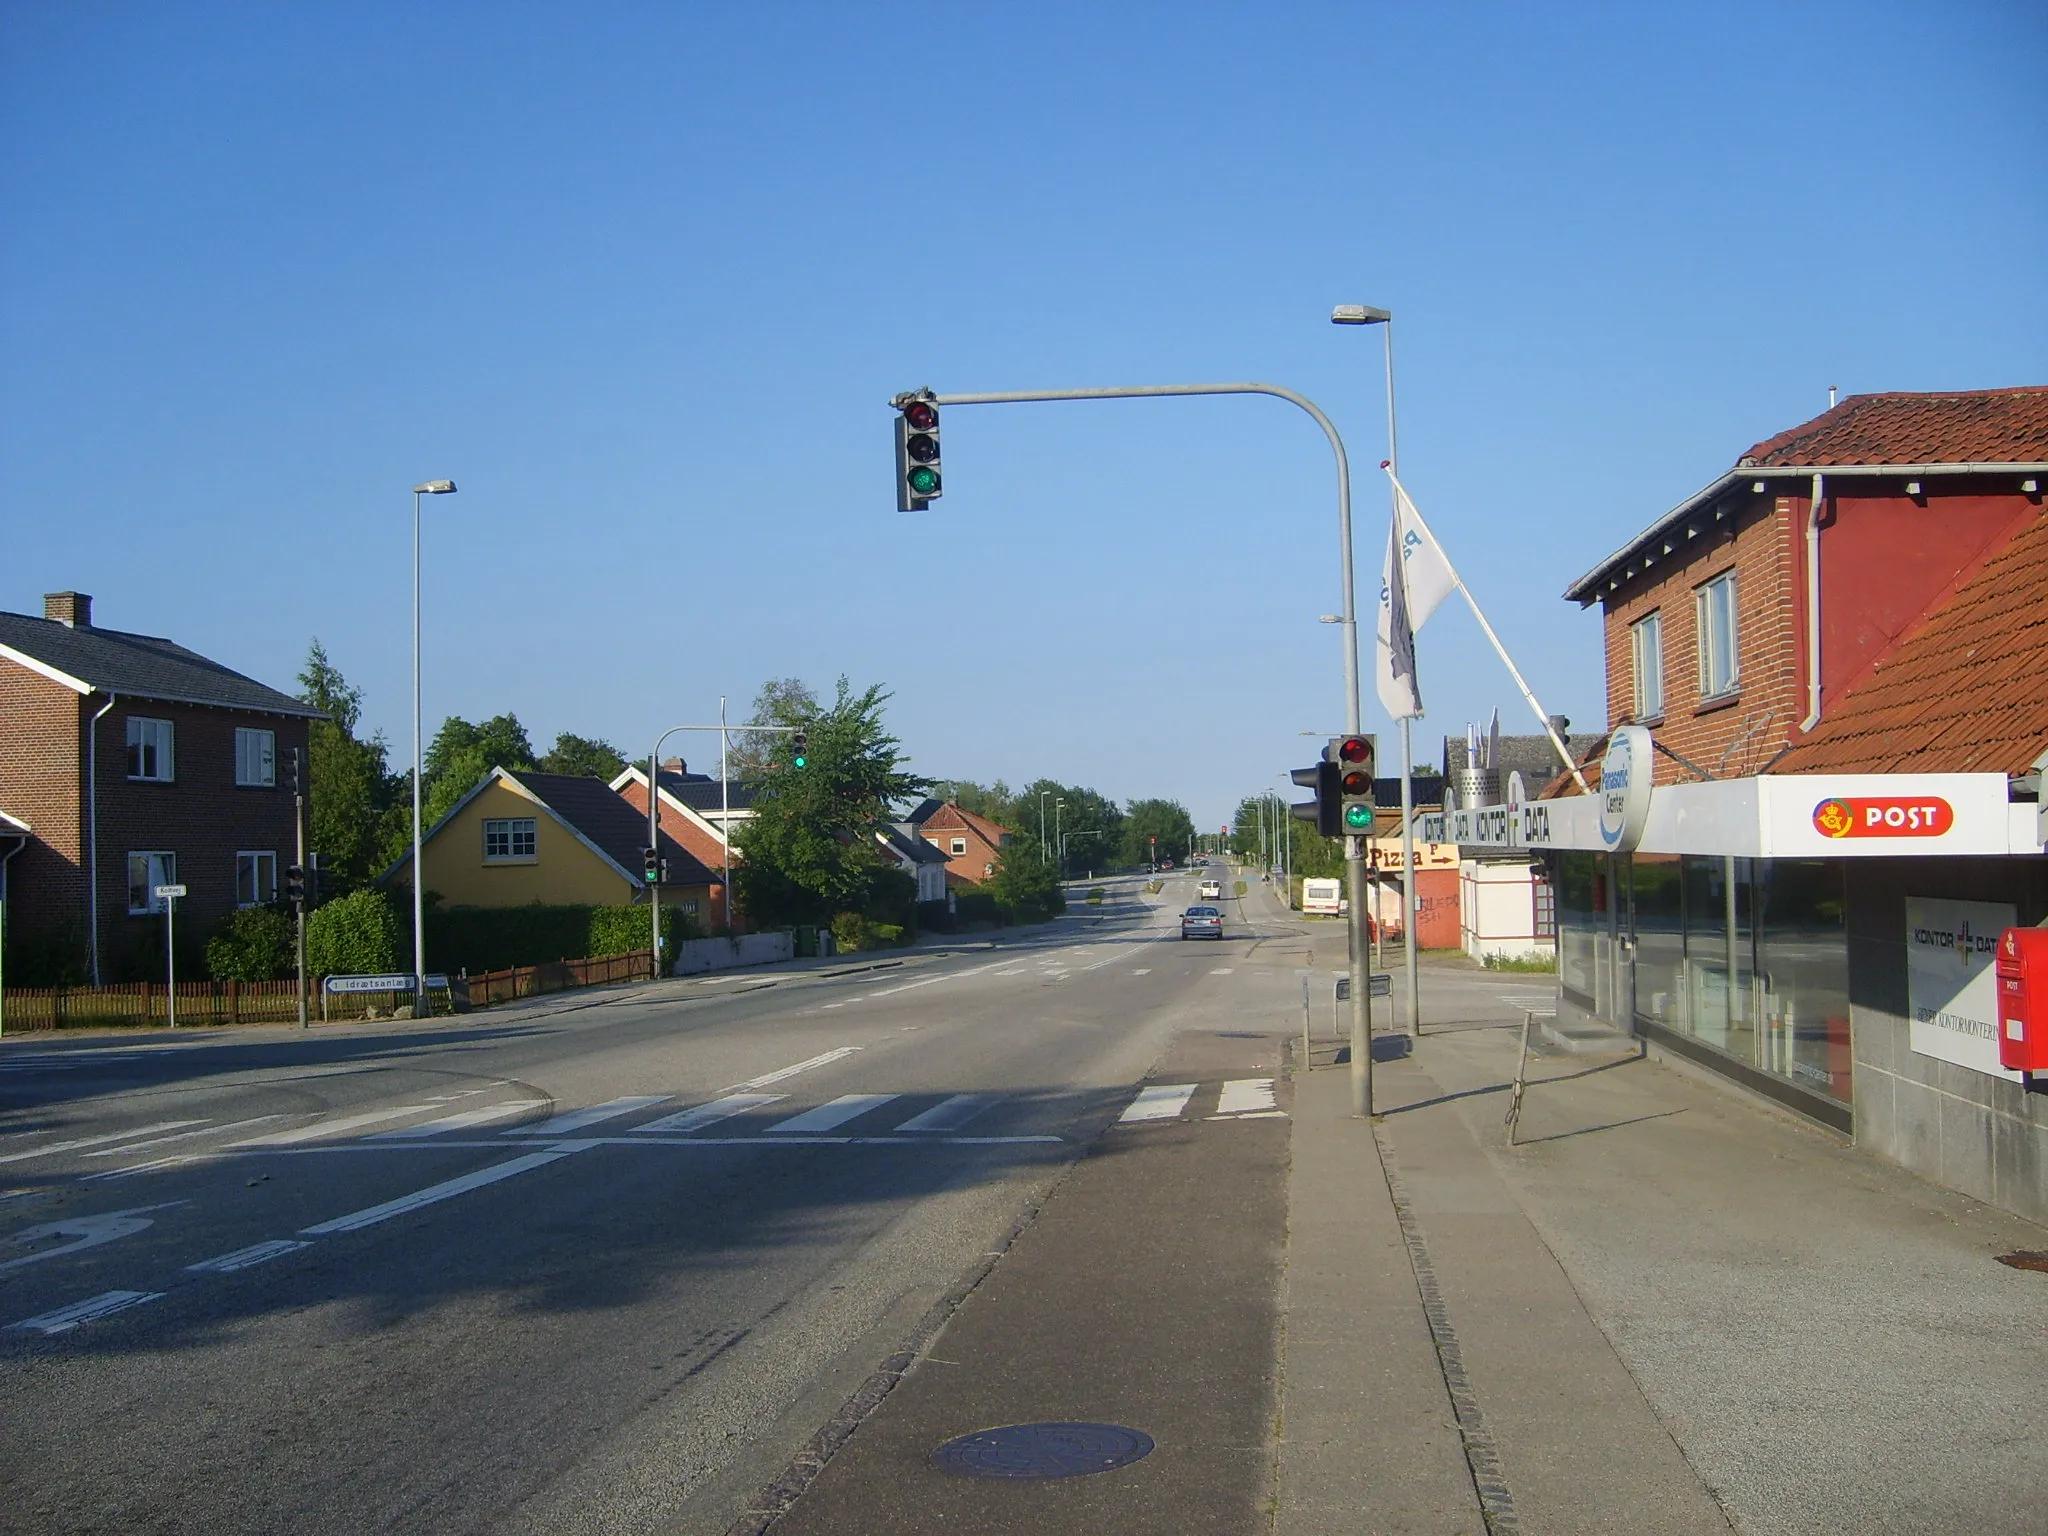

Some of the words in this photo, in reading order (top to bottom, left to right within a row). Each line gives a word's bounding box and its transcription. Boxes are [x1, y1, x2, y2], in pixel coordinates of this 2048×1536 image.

[1601, 763, 1628, 790] Panasonic
[1606, 792, 1625, 814] Center
[1476, 811, 1506, 841] KONTOR
[1525, 806, 1551, 842] DATA
[1866, 807, 1937, 829] POST
[1430, 844, 1438, 855] P
[1914, 928, 1954, 948] KONTOR
[1976, 936, 1997, 955] DAT
[346, 978, 411, 988] Idrætsanlæg
[2006, 981, 2018, 992] POST
